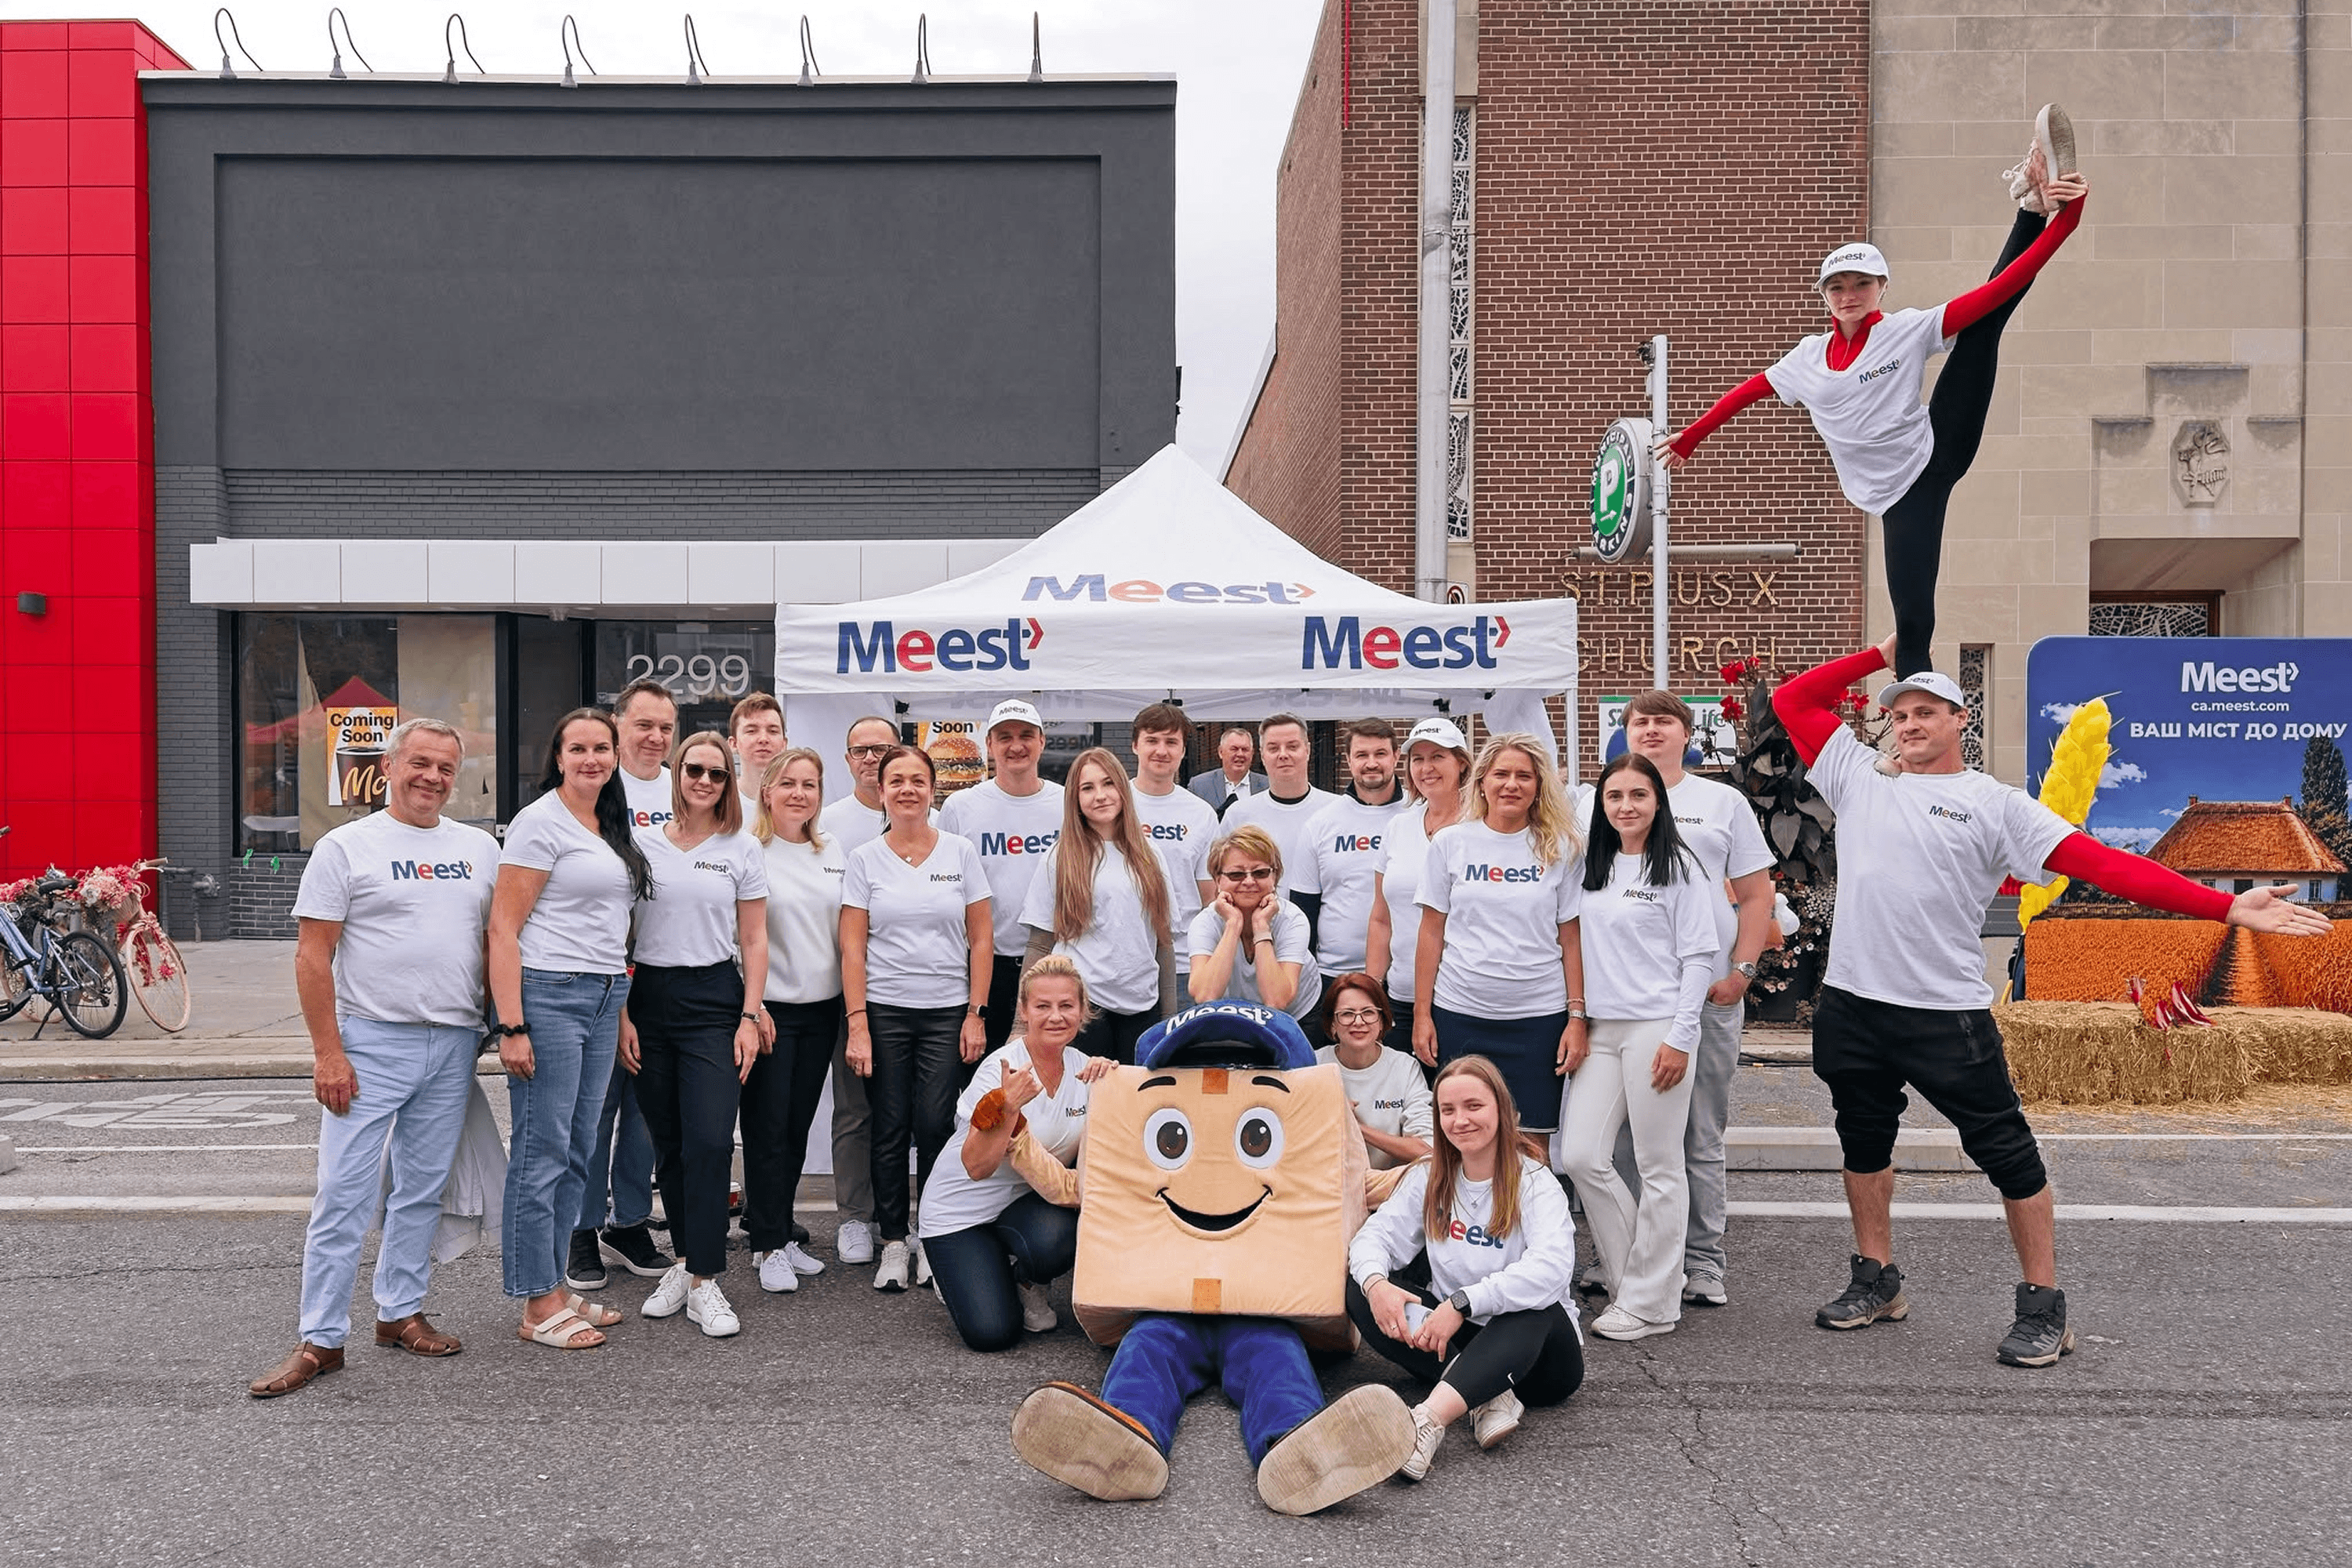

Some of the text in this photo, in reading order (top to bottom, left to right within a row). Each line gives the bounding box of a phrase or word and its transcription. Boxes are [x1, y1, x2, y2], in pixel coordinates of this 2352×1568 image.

[1828, 252, 1864, 267] Meest
[1859, 359, 1898, 384] Meest
[1021, 574, 1301, 604] Meest
[1630, 571, 1735, 607] PUS
[1749, 571, 1780, 606] X
[837, 618, 1031, 673] Meest
[1301, 615, 1498, 670] Meest
[627, 654, 750, 695] 2299
[2181, 662, 2292, 692] Meest
[2190, 701, 2290, 712] ca.meest.com
[330, 712, 394, 730] Coming
[932, 721, 974, 733] Soon
[342, 729, 383, 742] Soon
[2130, 723, 2348, 740] ВАШ МІСТ ДО ДОМУ
[626, 808, 673, 826] ees
[1929, 805, 1969, 823] Meest
[1142, 824, 1183, 841] eest
[1334, 834, 1381, 853] Mee
[391, 860, 470, 880] Meest
[694, 861, 728, 873] Meest
[1465, 864, 1541, 883] Meest
[930, 873, 961, 882] Meest
[1622, 888, 1654, 902] Meest
[1375, 1099, 1404, 1109] Meest
[1450, 1220, 1504, 1249] ees
